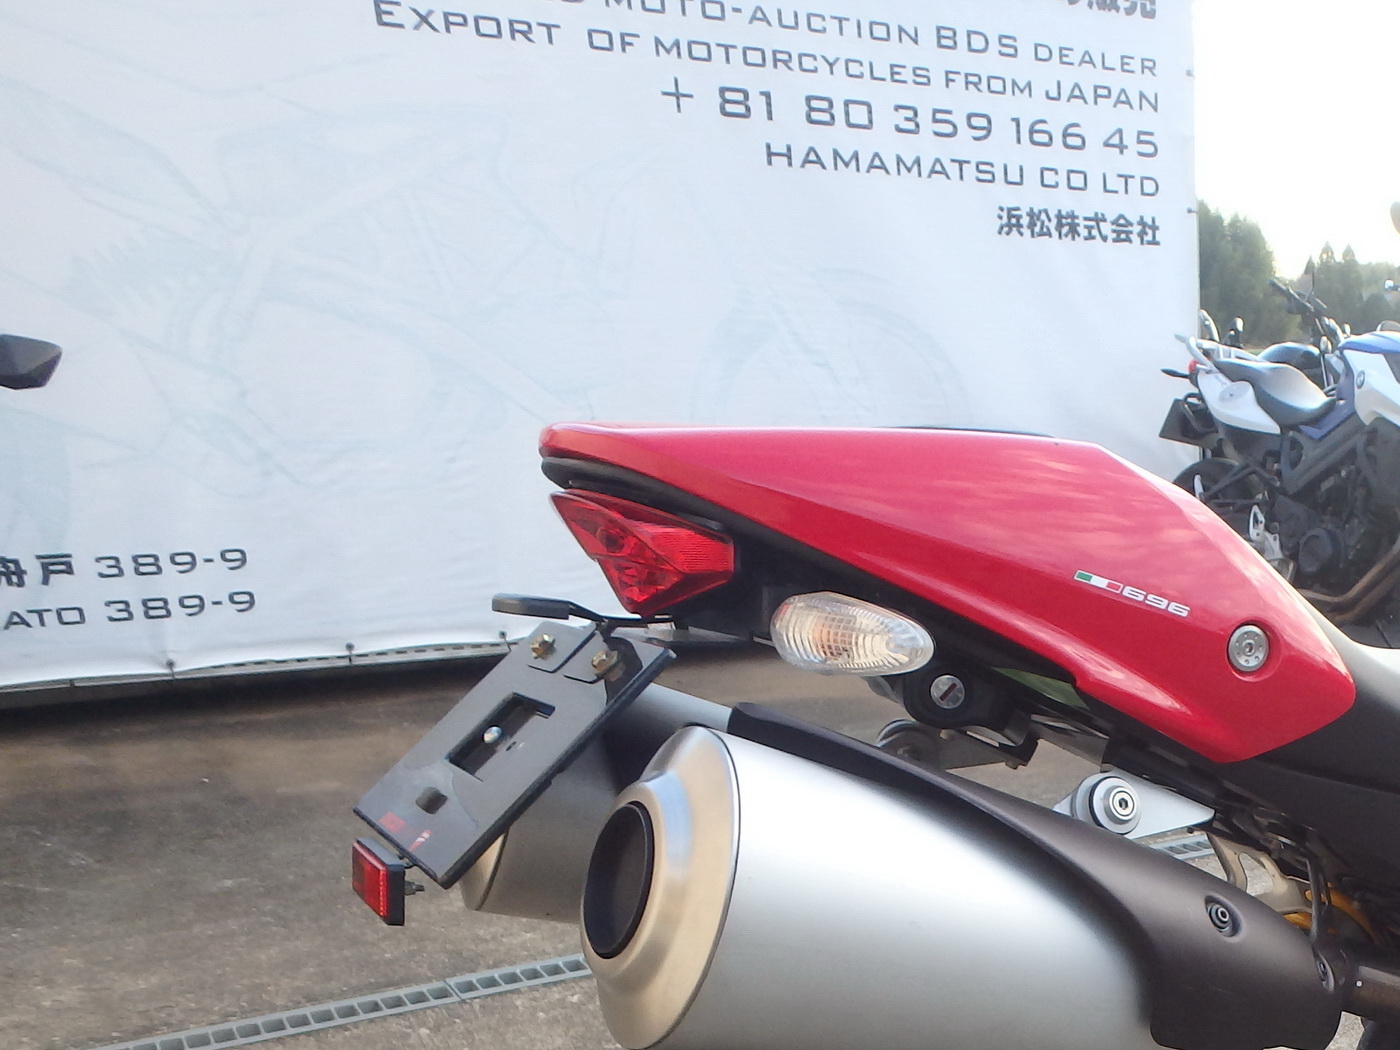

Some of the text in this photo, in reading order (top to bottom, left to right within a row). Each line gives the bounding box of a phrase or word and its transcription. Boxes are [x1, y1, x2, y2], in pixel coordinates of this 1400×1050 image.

[373, 0, 1159, 113] EXPORT OF MOTORCYCLES FROM JAPAN
[935, 26, 1019, 58] BDS
[1033, 43, 1157, 77] DEALER
[717, 86, 774, 121] 81
[804, 95, 874, 130] 80
[893, 104, 993, 141] 359
[1010, 117, 1087, 150] 166
[1102, 128, 1159, 158] 45
[765, 142, 1160, 197] HAMAMATSU CO LTD
[996, 206, 1161, 247] 浜松株式会社
[95, 548, 248, 579] 389-9
[104, 590, 256, 622] 389-9
[1122, 585, 1191, 617] 696
